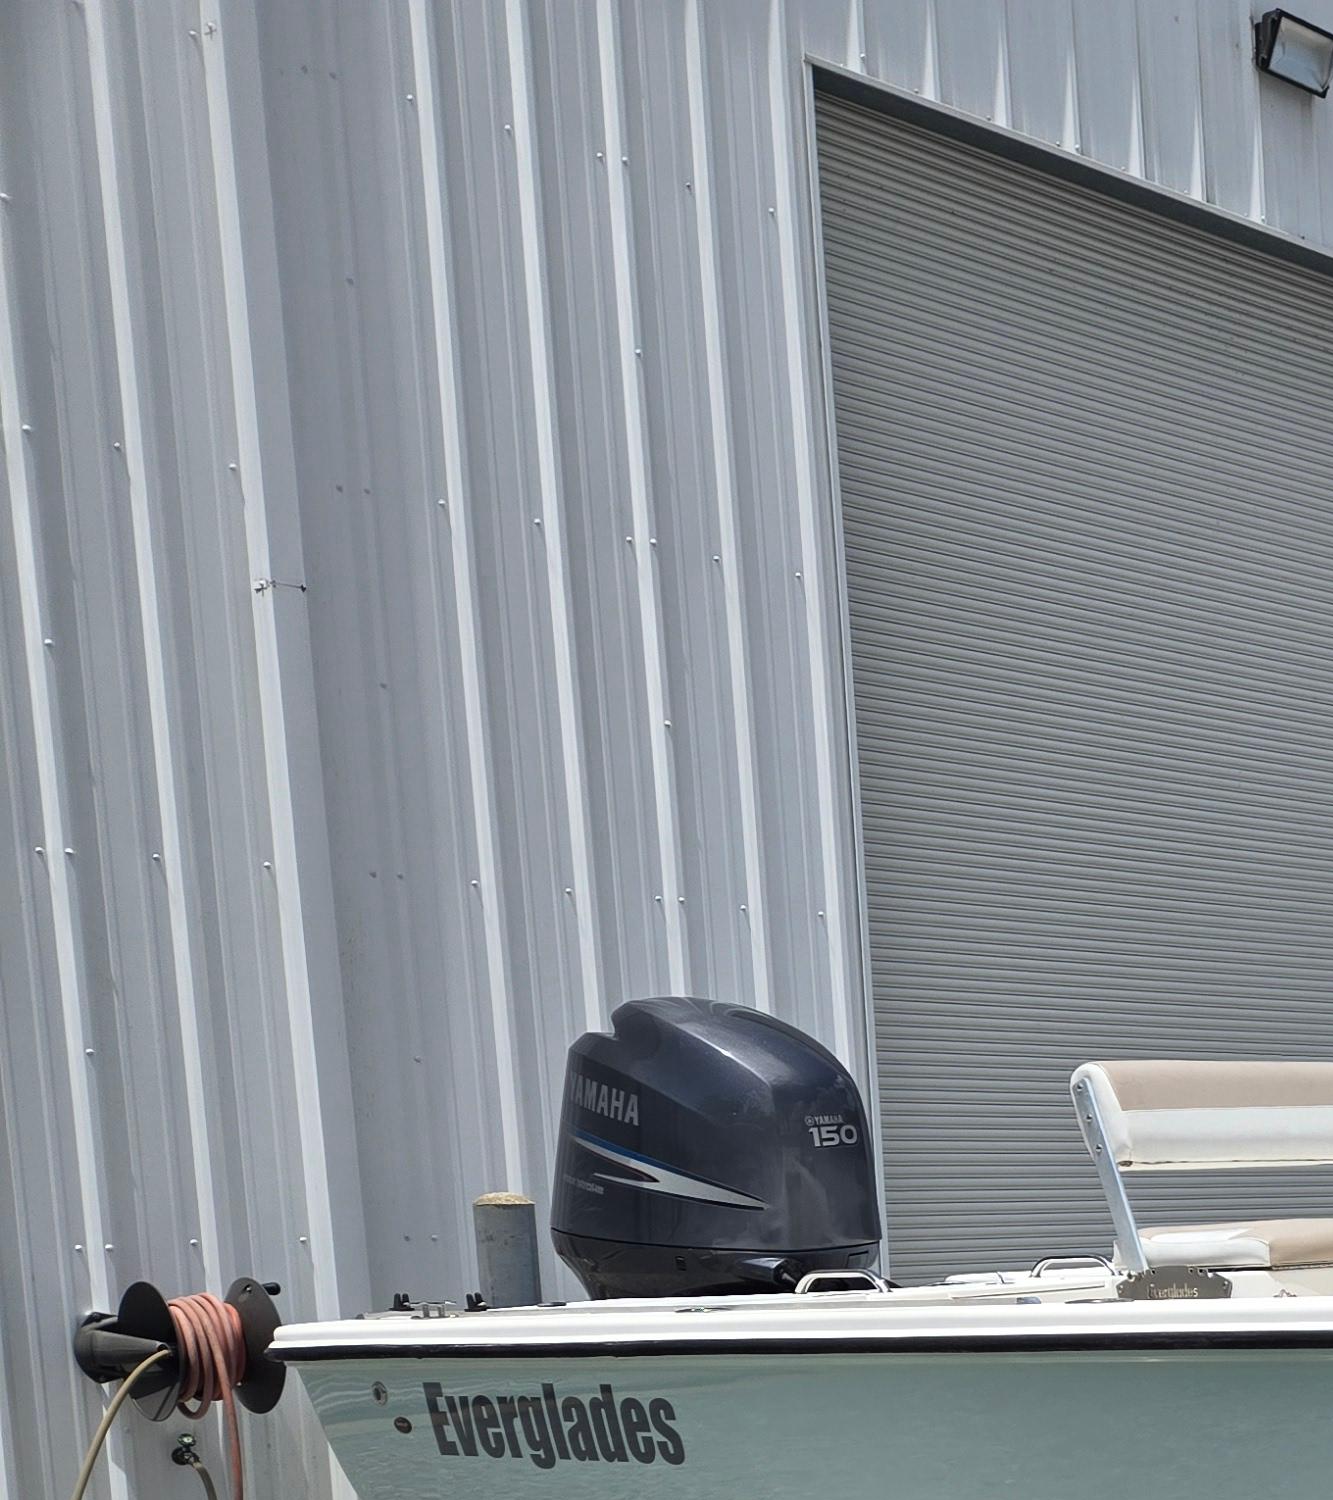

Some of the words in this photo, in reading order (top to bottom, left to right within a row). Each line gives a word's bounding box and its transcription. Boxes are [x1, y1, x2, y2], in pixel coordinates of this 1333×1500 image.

[570, 1072, 639, 1126] YAMAHA
[808, 1124, 858, 1147] 150
[422, 1381, 686, 1470] Everglades
